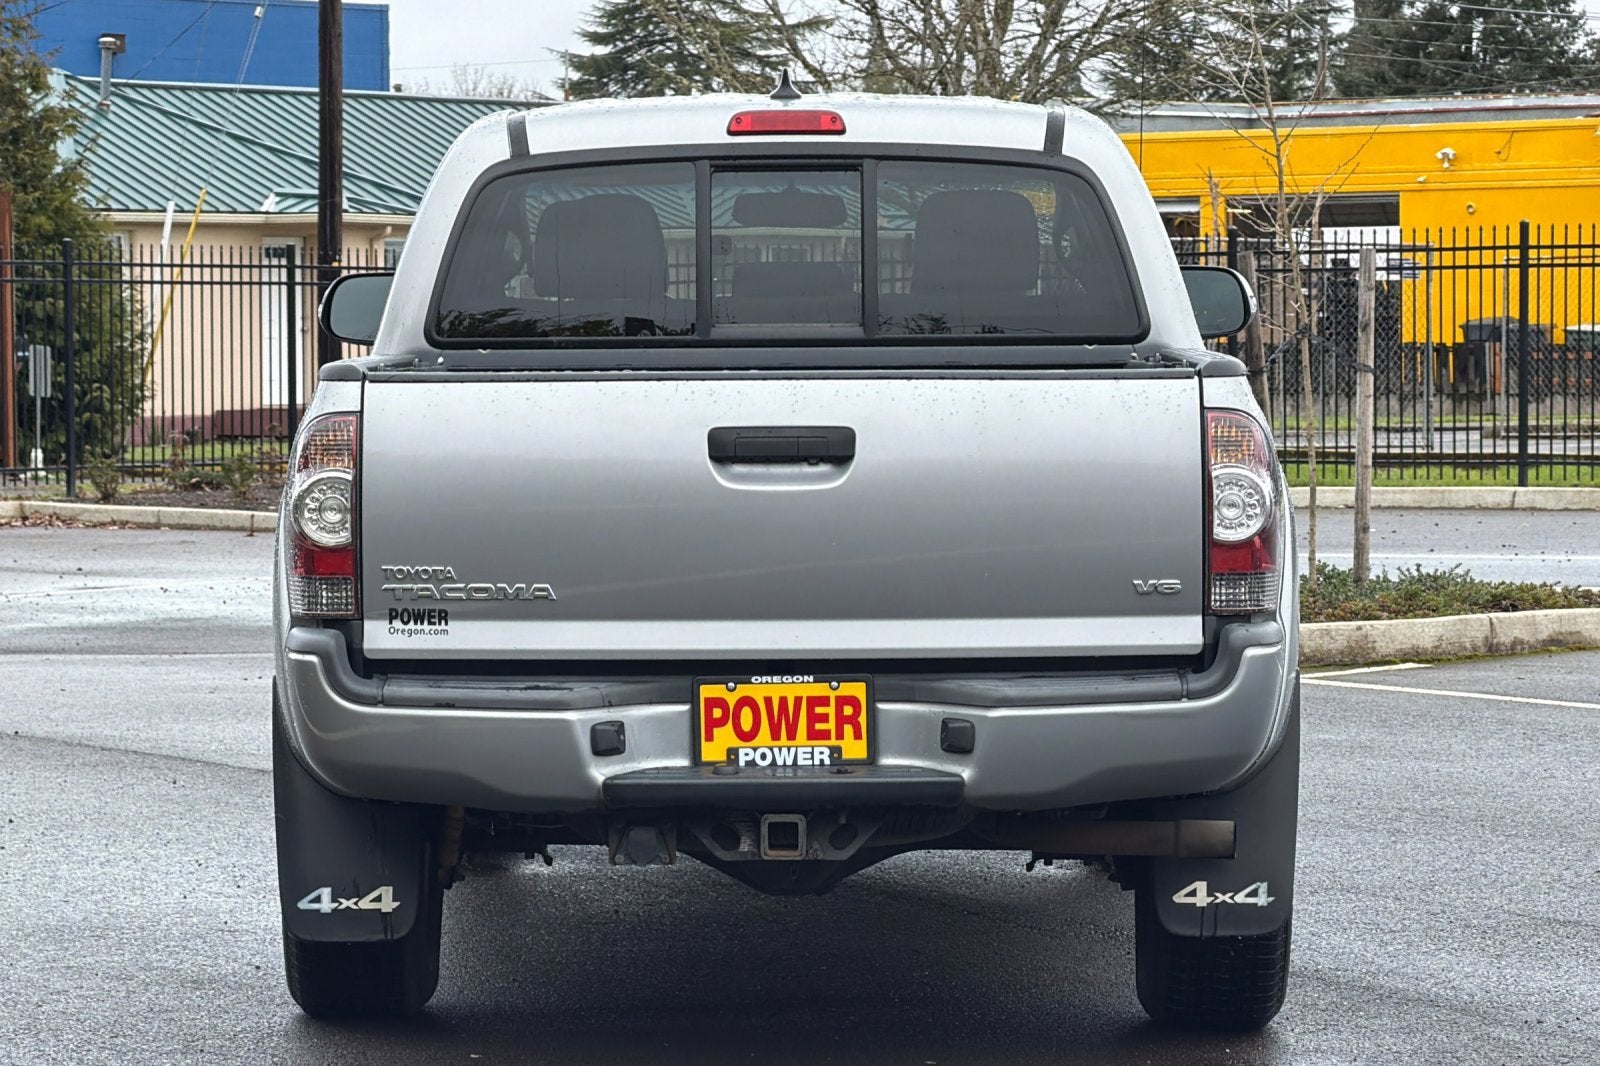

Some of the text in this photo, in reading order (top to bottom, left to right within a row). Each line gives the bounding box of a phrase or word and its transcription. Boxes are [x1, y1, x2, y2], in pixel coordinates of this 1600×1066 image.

[381, 565, 456, 580] TOYOTA
[381, 583, 557, 600] TACOMA
[1132, 579, 1182, 594] V6
[388, 608, 449, 626] POWER
[388, 626, 449, 637] Oregon.com
[751, 675, 814, 684] OREGON
[703, 695, 863, 743] POWER
[738, 746, 831, 767] POWER
[297, 886, 400, 913] 4x4
[1172, 881, 1275, 906] 4x4
